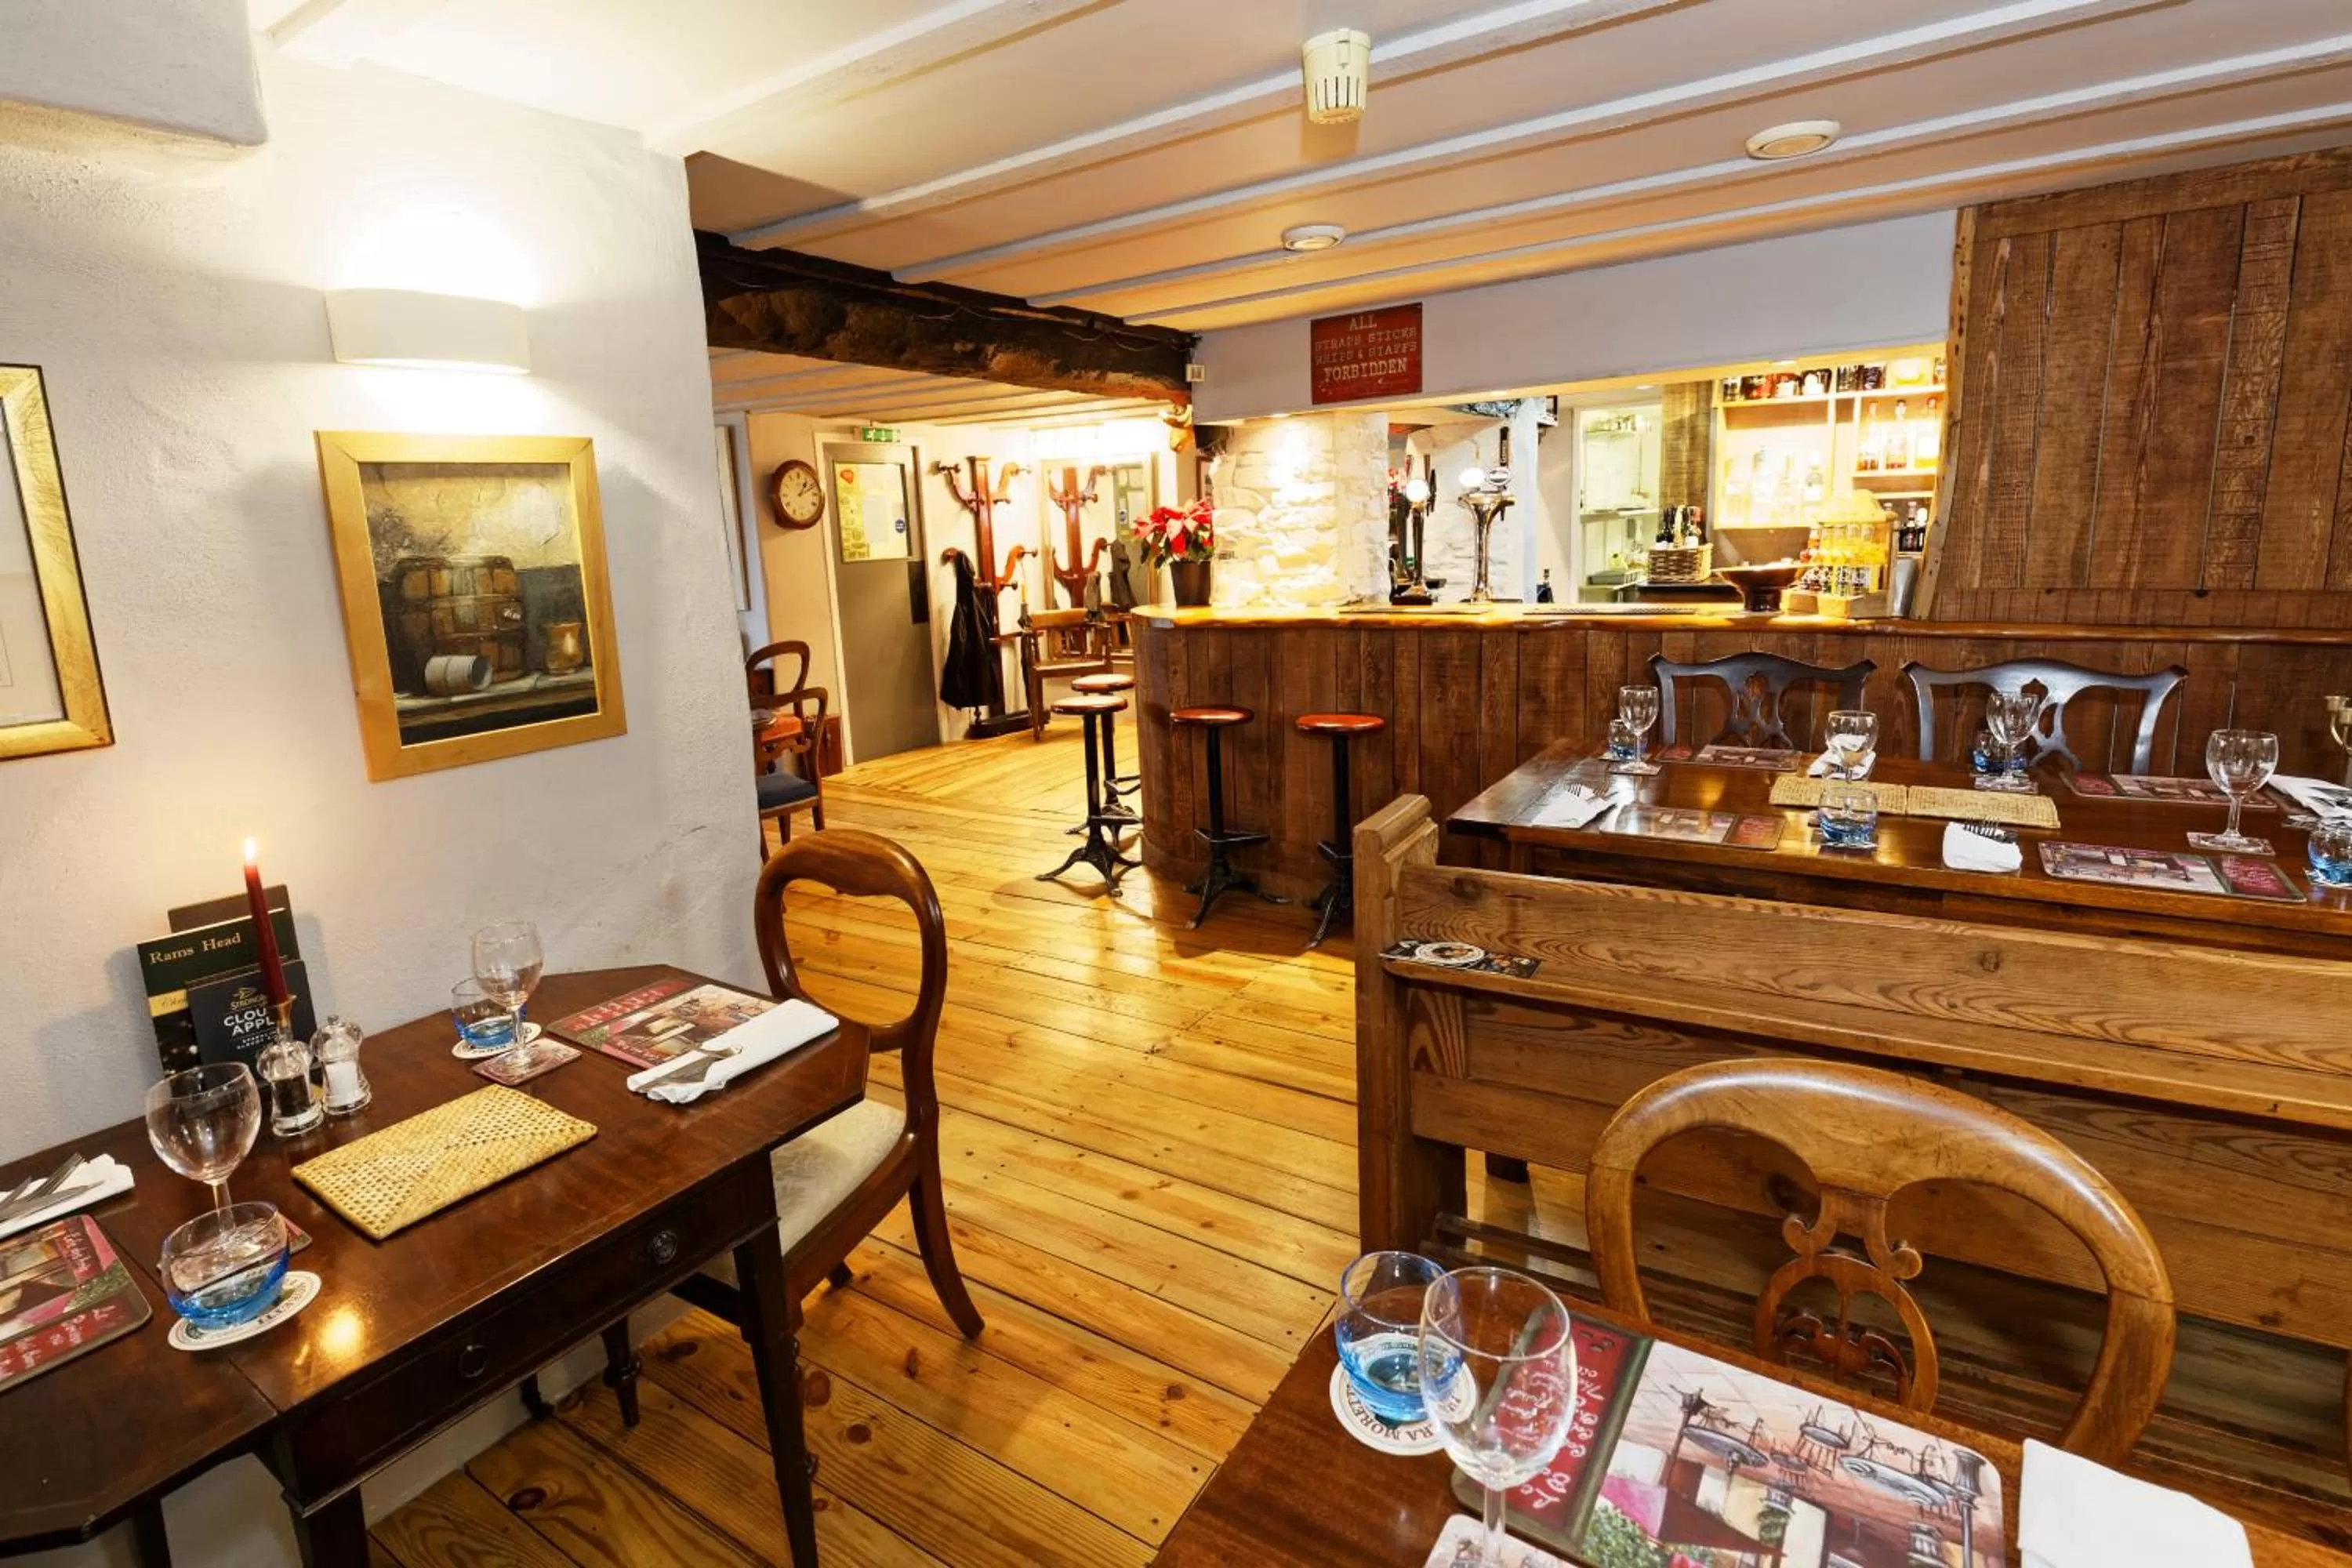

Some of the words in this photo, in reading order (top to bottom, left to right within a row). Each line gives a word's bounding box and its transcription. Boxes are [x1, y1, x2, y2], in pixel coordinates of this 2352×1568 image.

[1349, 314, 1377, 331] ALL
[1368, 326, 1417, 343] STICKS
[1323, 357, 1407, 383] FORBIDDEN
[149, 947, 194, 965] Rams
[201, 932, 241, 952] Head
[223, 1007, 267, 1026] CLOU
[232, 1016, 275, 1036] APPL
[1346, 1382, 1399, 1440] MORETT
